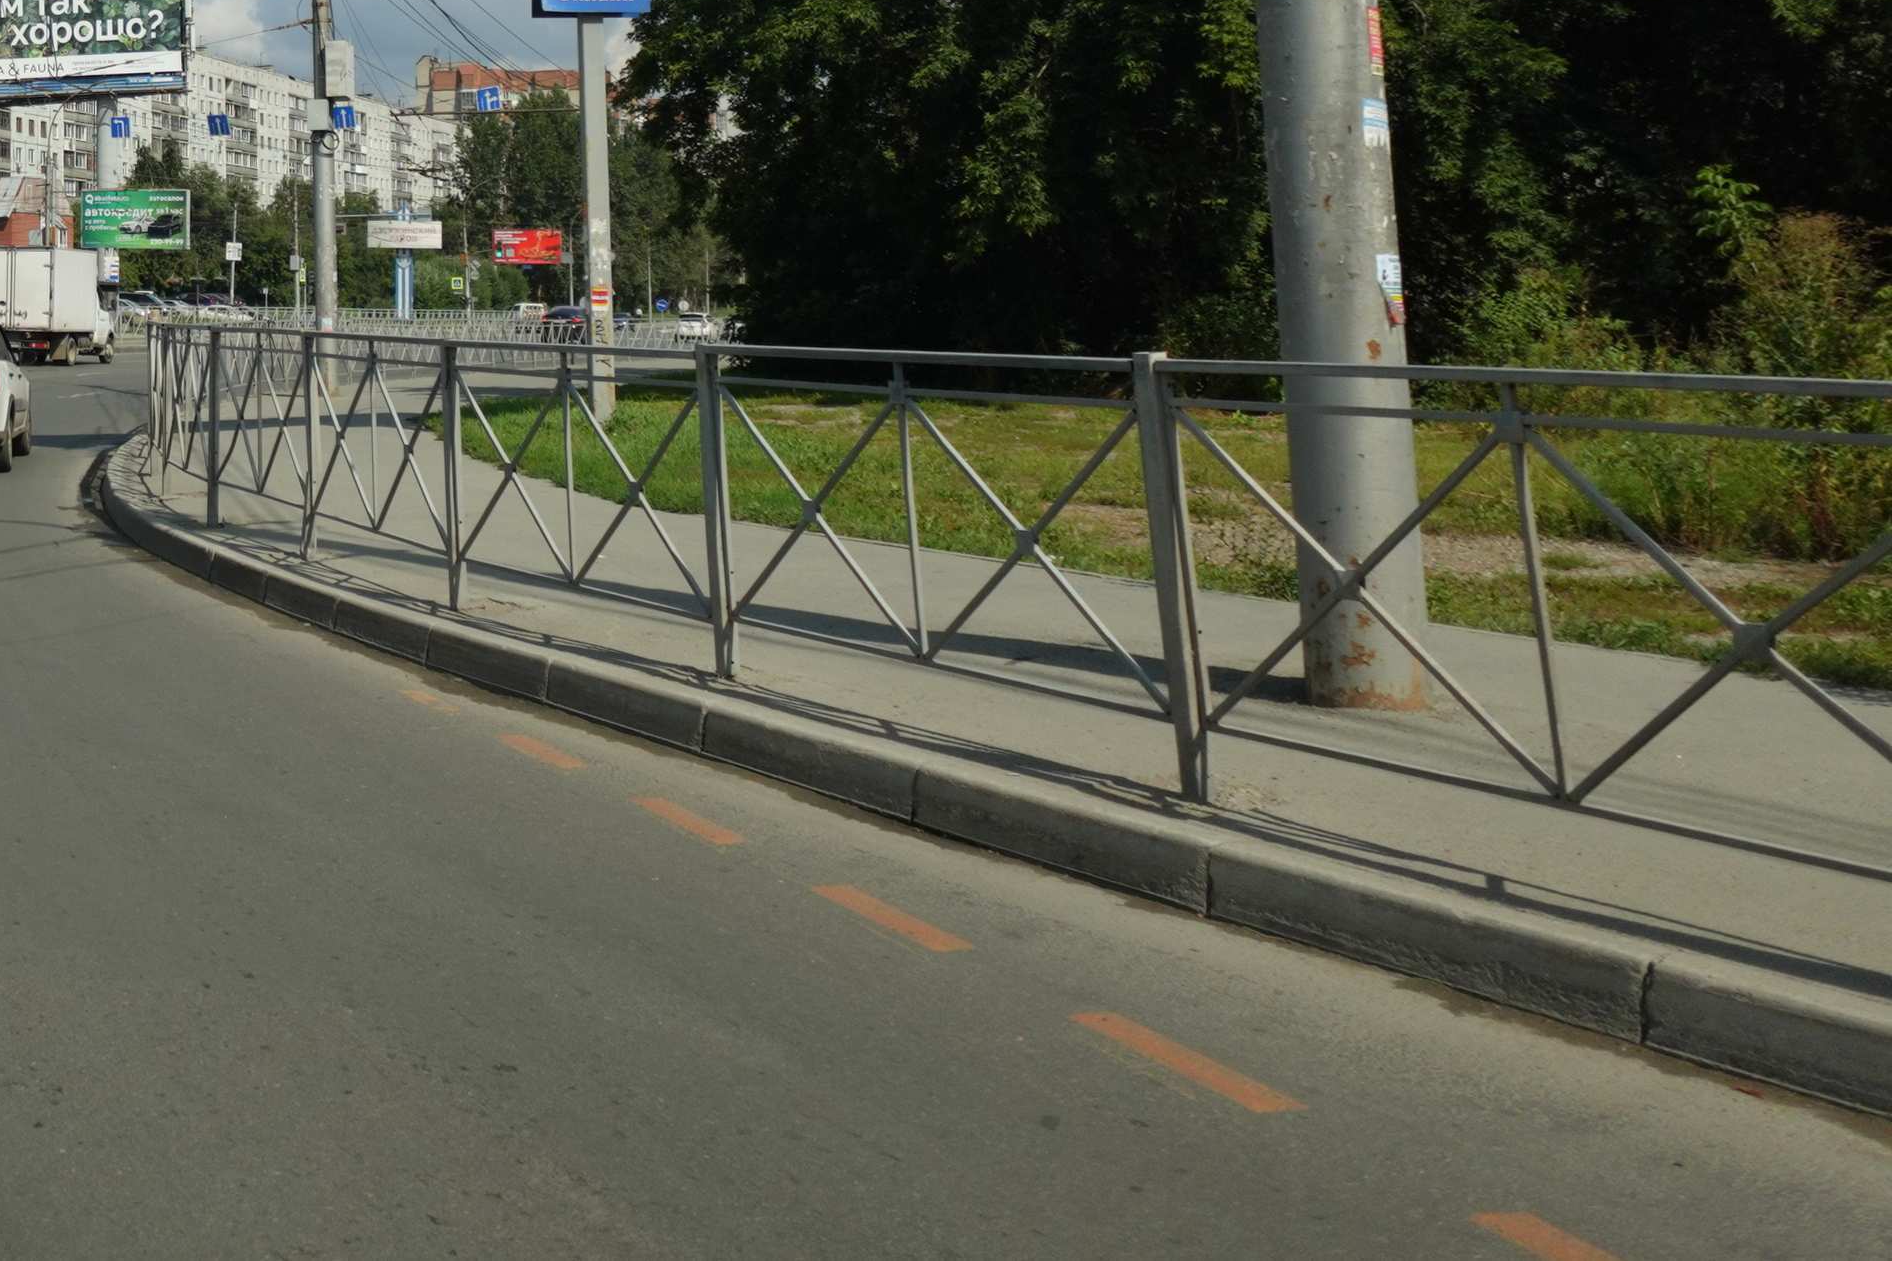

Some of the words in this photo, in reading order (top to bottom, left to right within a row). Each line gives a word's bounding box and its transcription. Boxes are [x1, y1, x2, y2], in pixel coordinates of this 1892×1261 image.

[10, 9, 165, 51] хорошо?
[8, 63, 20, 78] &
[23, 63, 65, 75] FAUNA
[84, 208, 154, 220] автокредит
